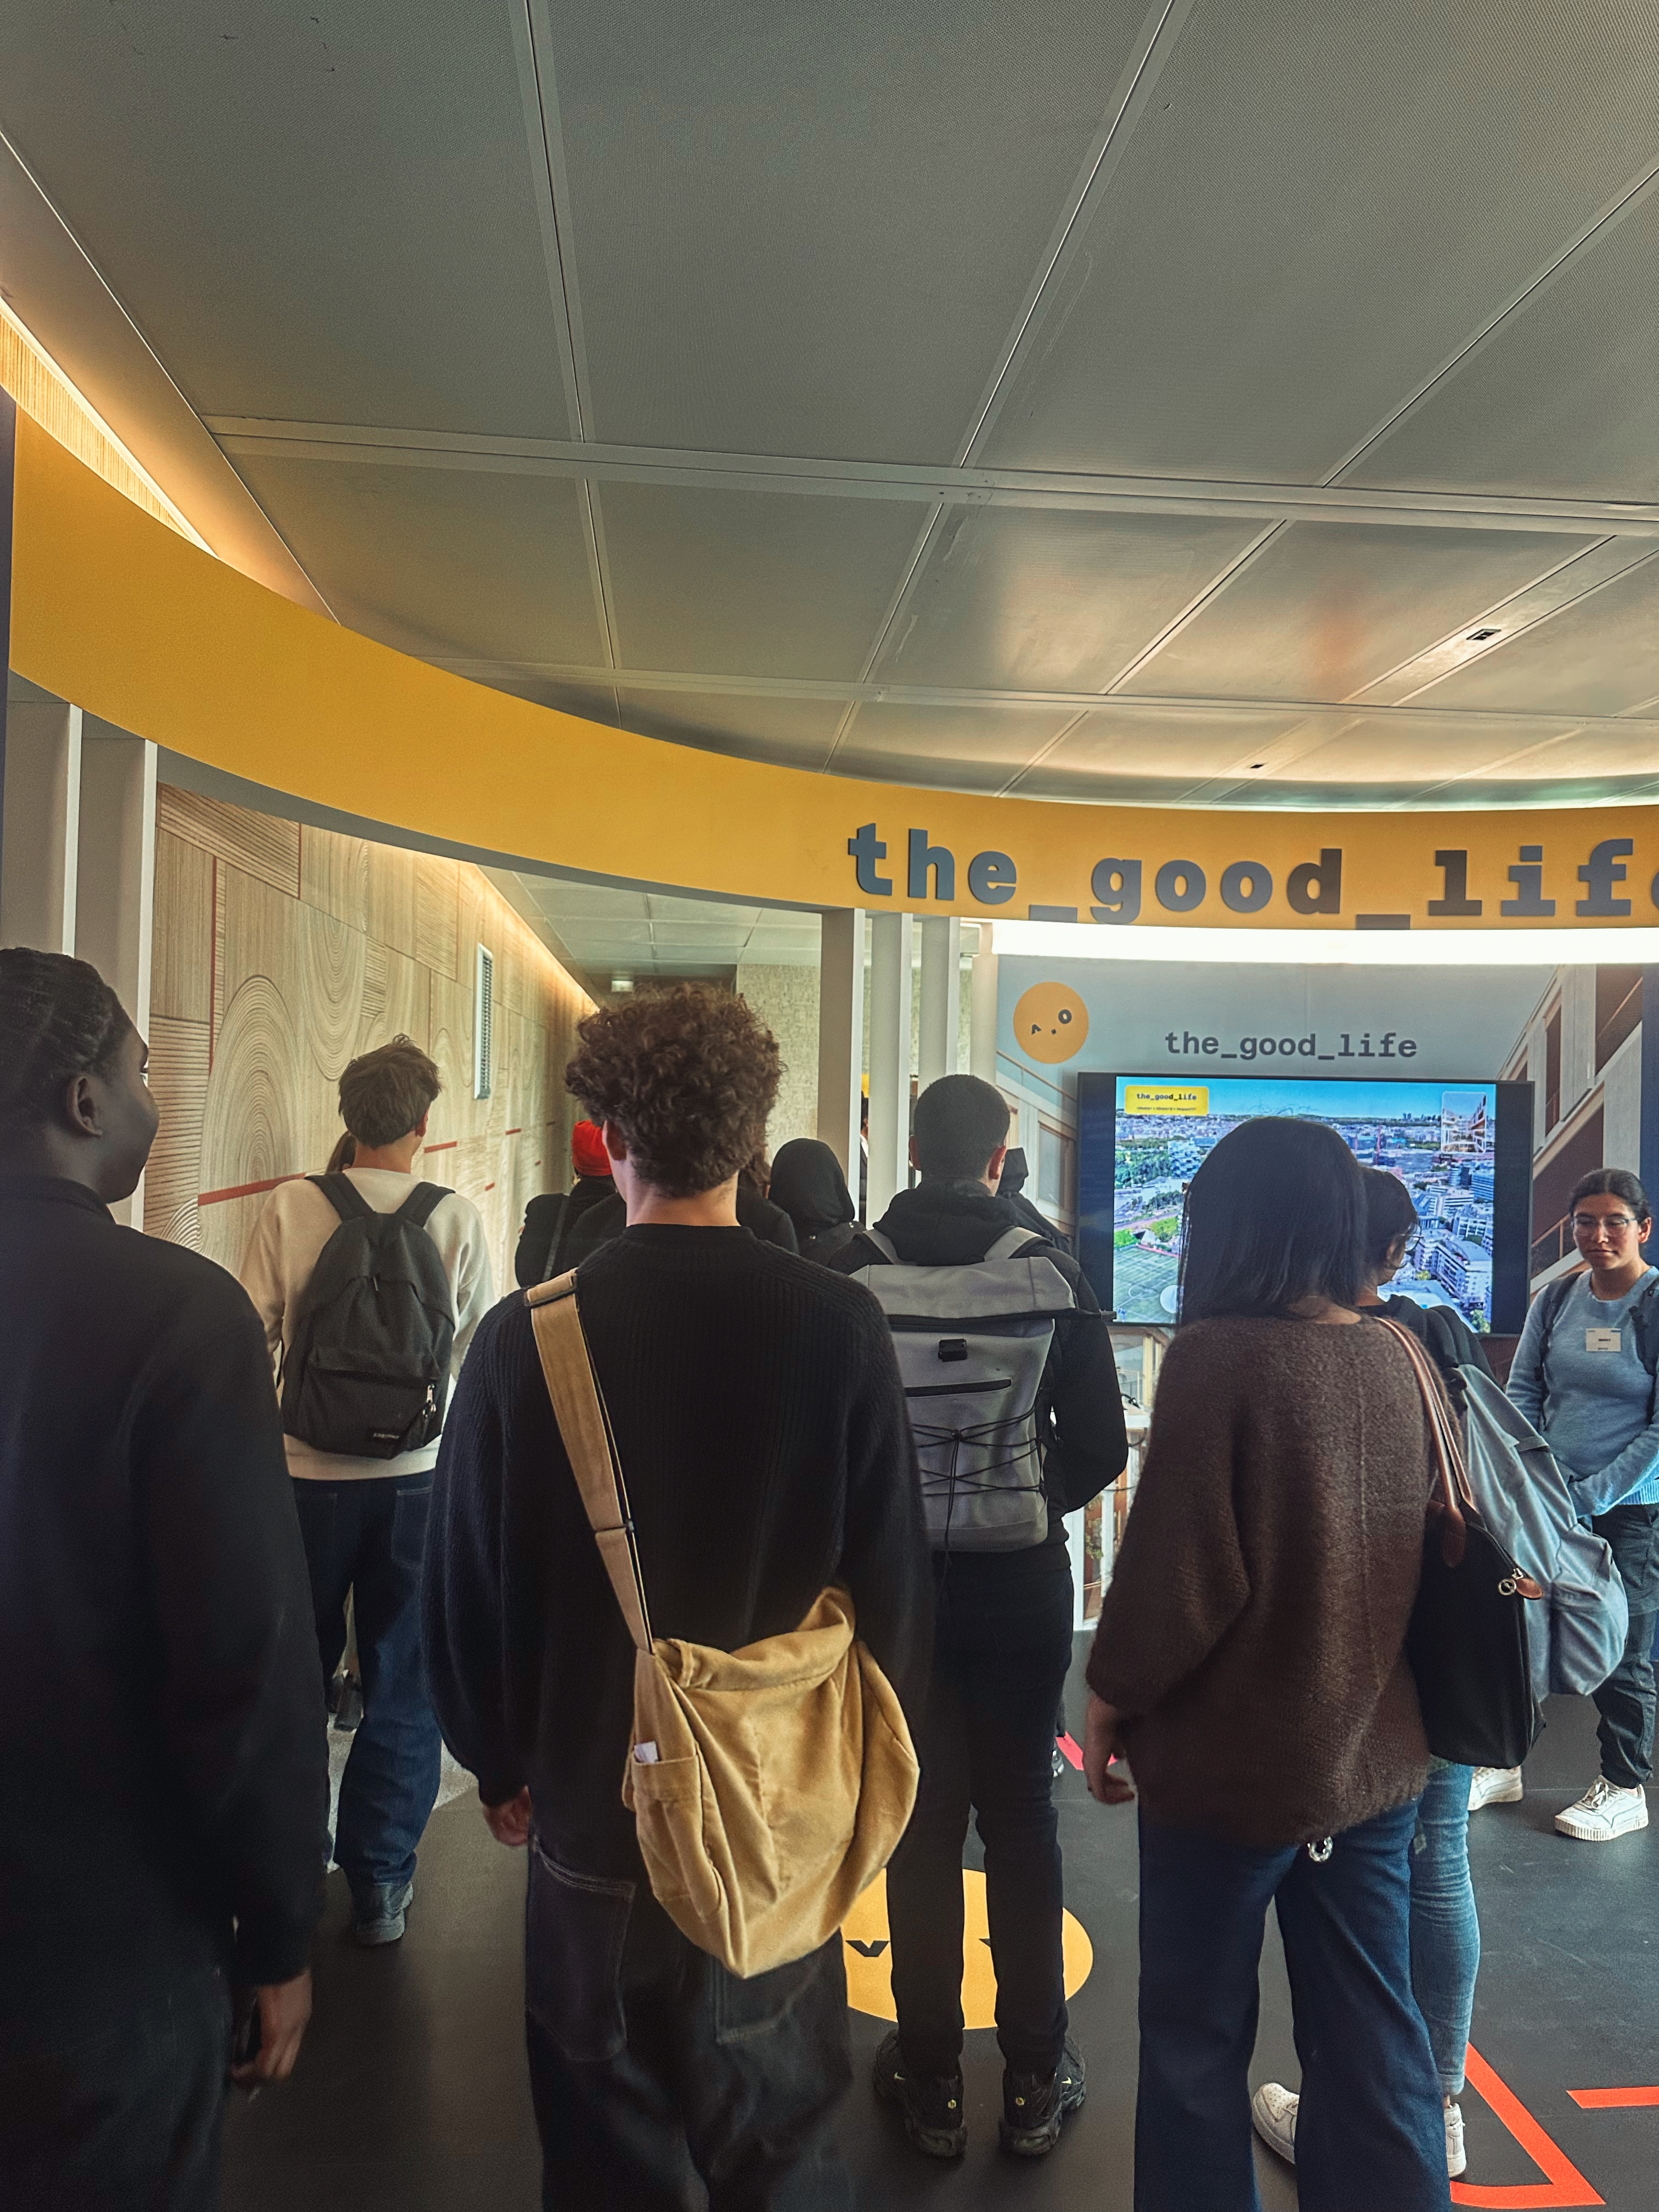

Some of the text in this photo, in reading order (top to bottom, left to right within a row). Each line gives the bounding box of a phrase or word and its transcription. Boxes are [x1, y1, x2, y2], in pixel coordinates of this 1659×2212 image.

[848, 823, 1659, 930] the_good_lif
[1165, 1031, 1417, 1060] the_good_life
[1136, 1093, 1197, 1101] the_good_life
